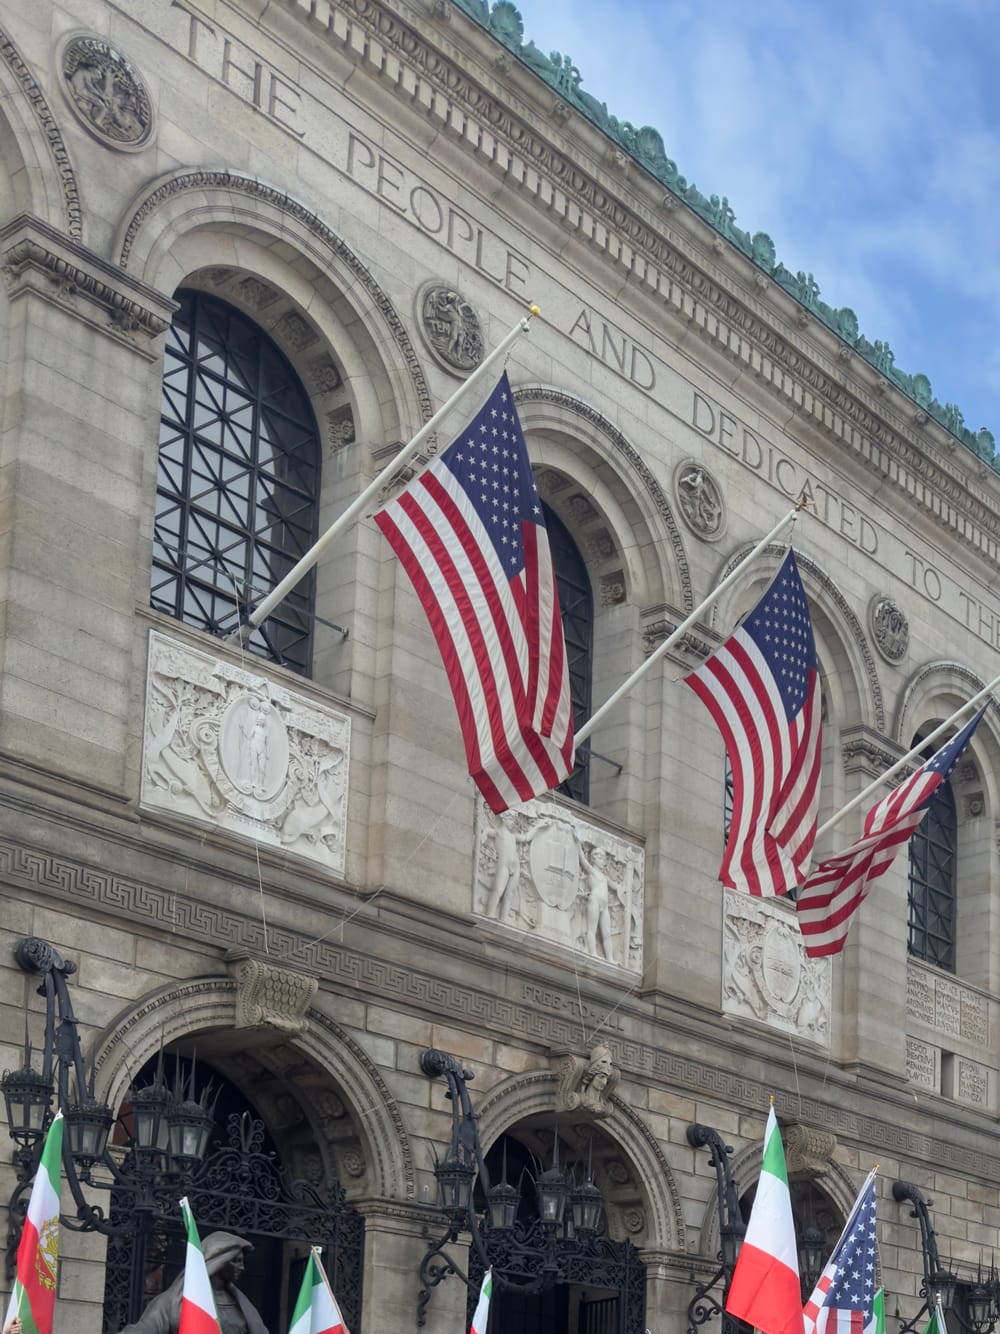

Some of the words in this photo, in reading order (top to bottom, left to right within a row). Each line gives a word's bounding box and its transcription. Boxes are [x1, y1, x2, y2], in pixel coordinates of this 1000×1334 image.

[171, 0, 306, 139] THE
[345, 130, 533, 305] PEOPLE
[568, 308, 657, 391] AND
[692, 391, 879, 556] DEDICATED
[904, 550, 942, 602] TO
[521, 984, 561, 1009] FREE
